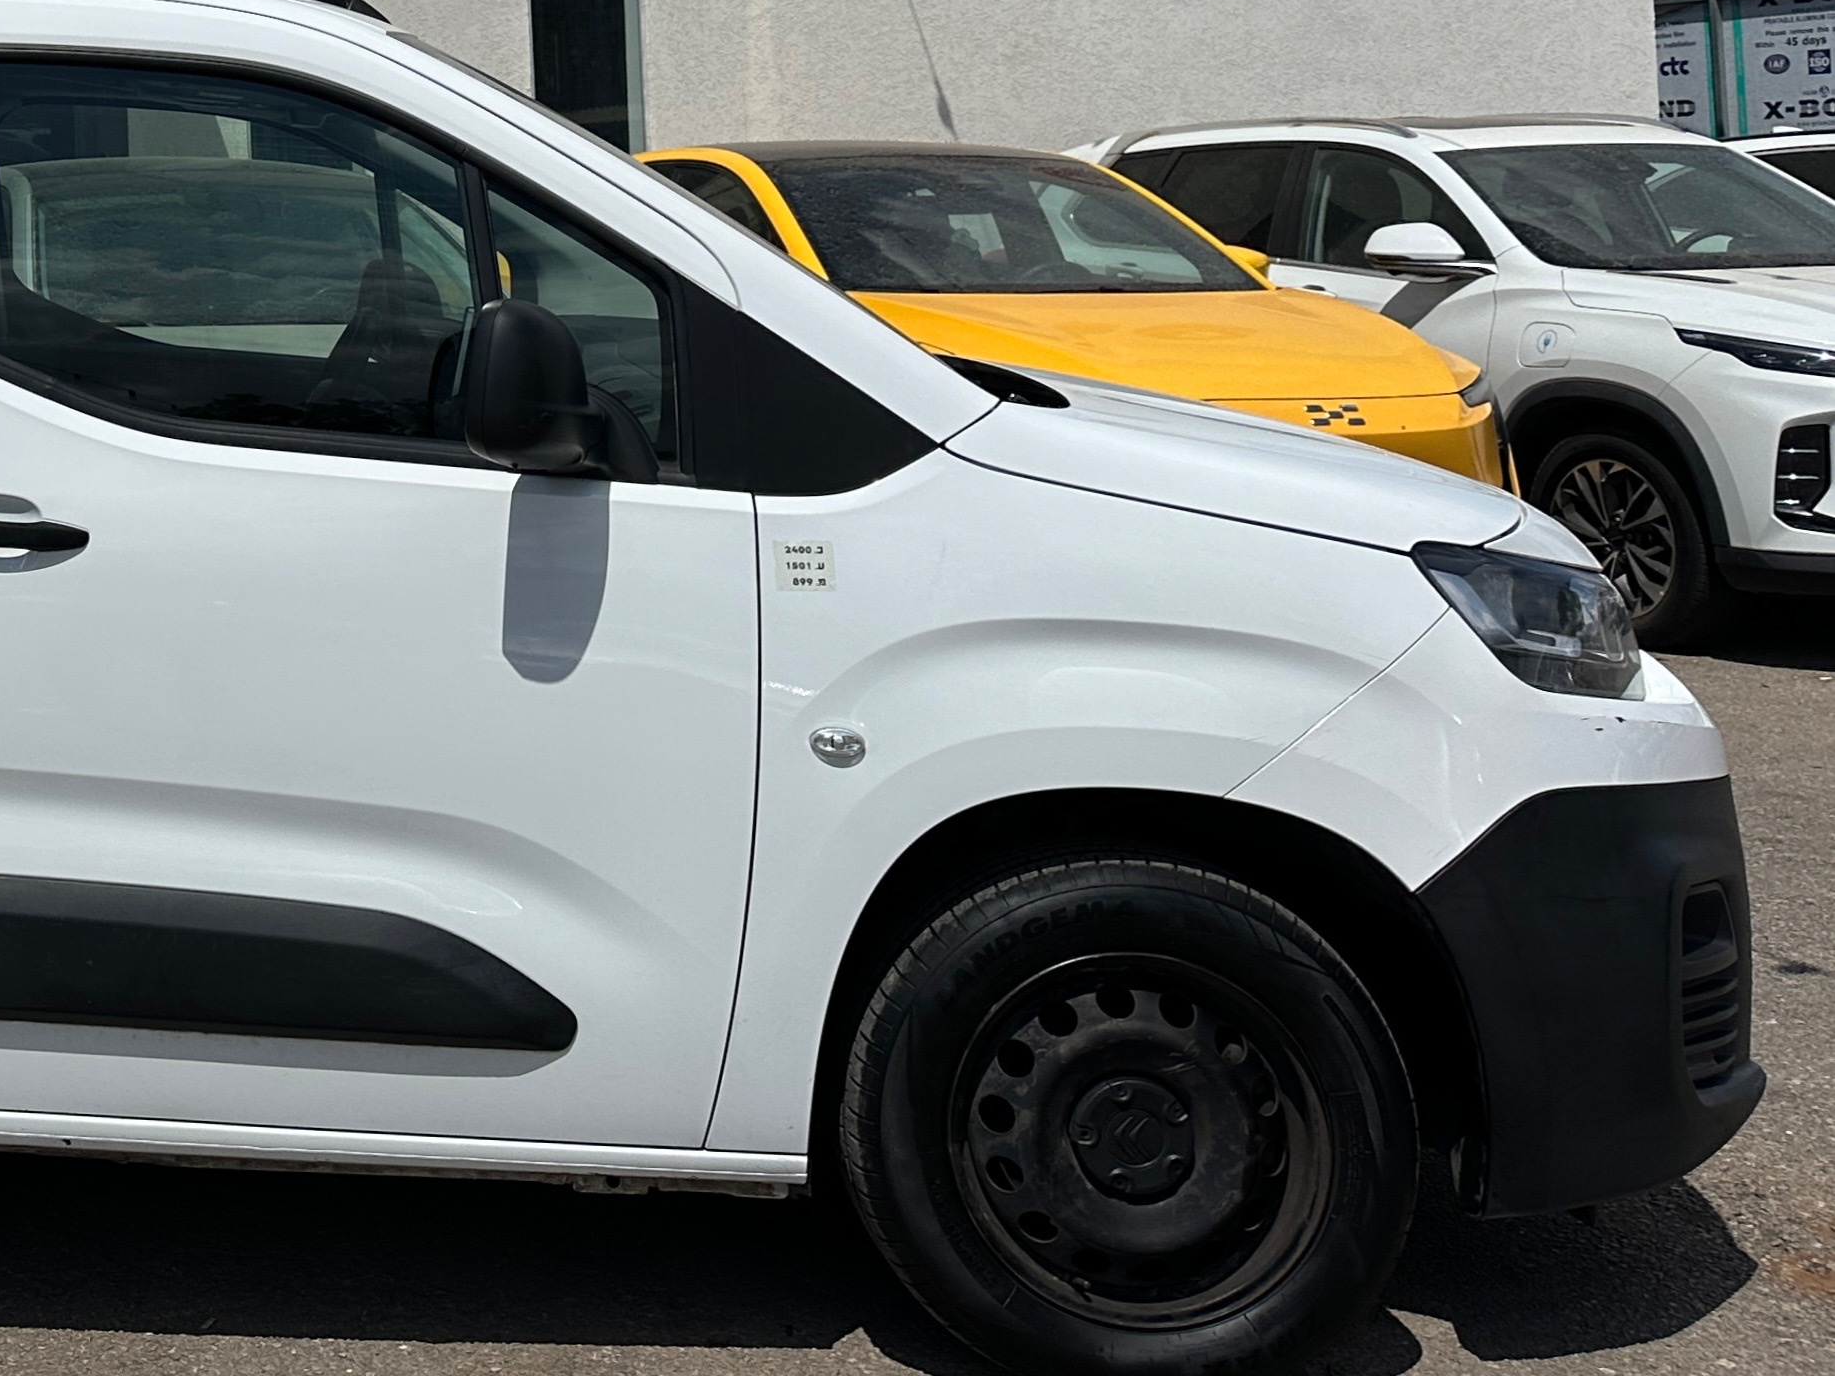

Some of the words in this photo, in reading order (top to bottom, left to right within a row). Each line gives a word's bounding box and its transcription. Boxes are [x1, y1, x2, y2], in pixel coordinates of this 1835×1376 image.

[1786, 36, 1799, 46] 45
[1802, 35, 1827, 47] days
[1659, 56, 1691, 76] ctc
[1809, 56, 1830, 67] ISO
[784, 545, 813, 554] 2400
[786, 561, 812, 570] 1501
[792, 577, 814, 586] 899
